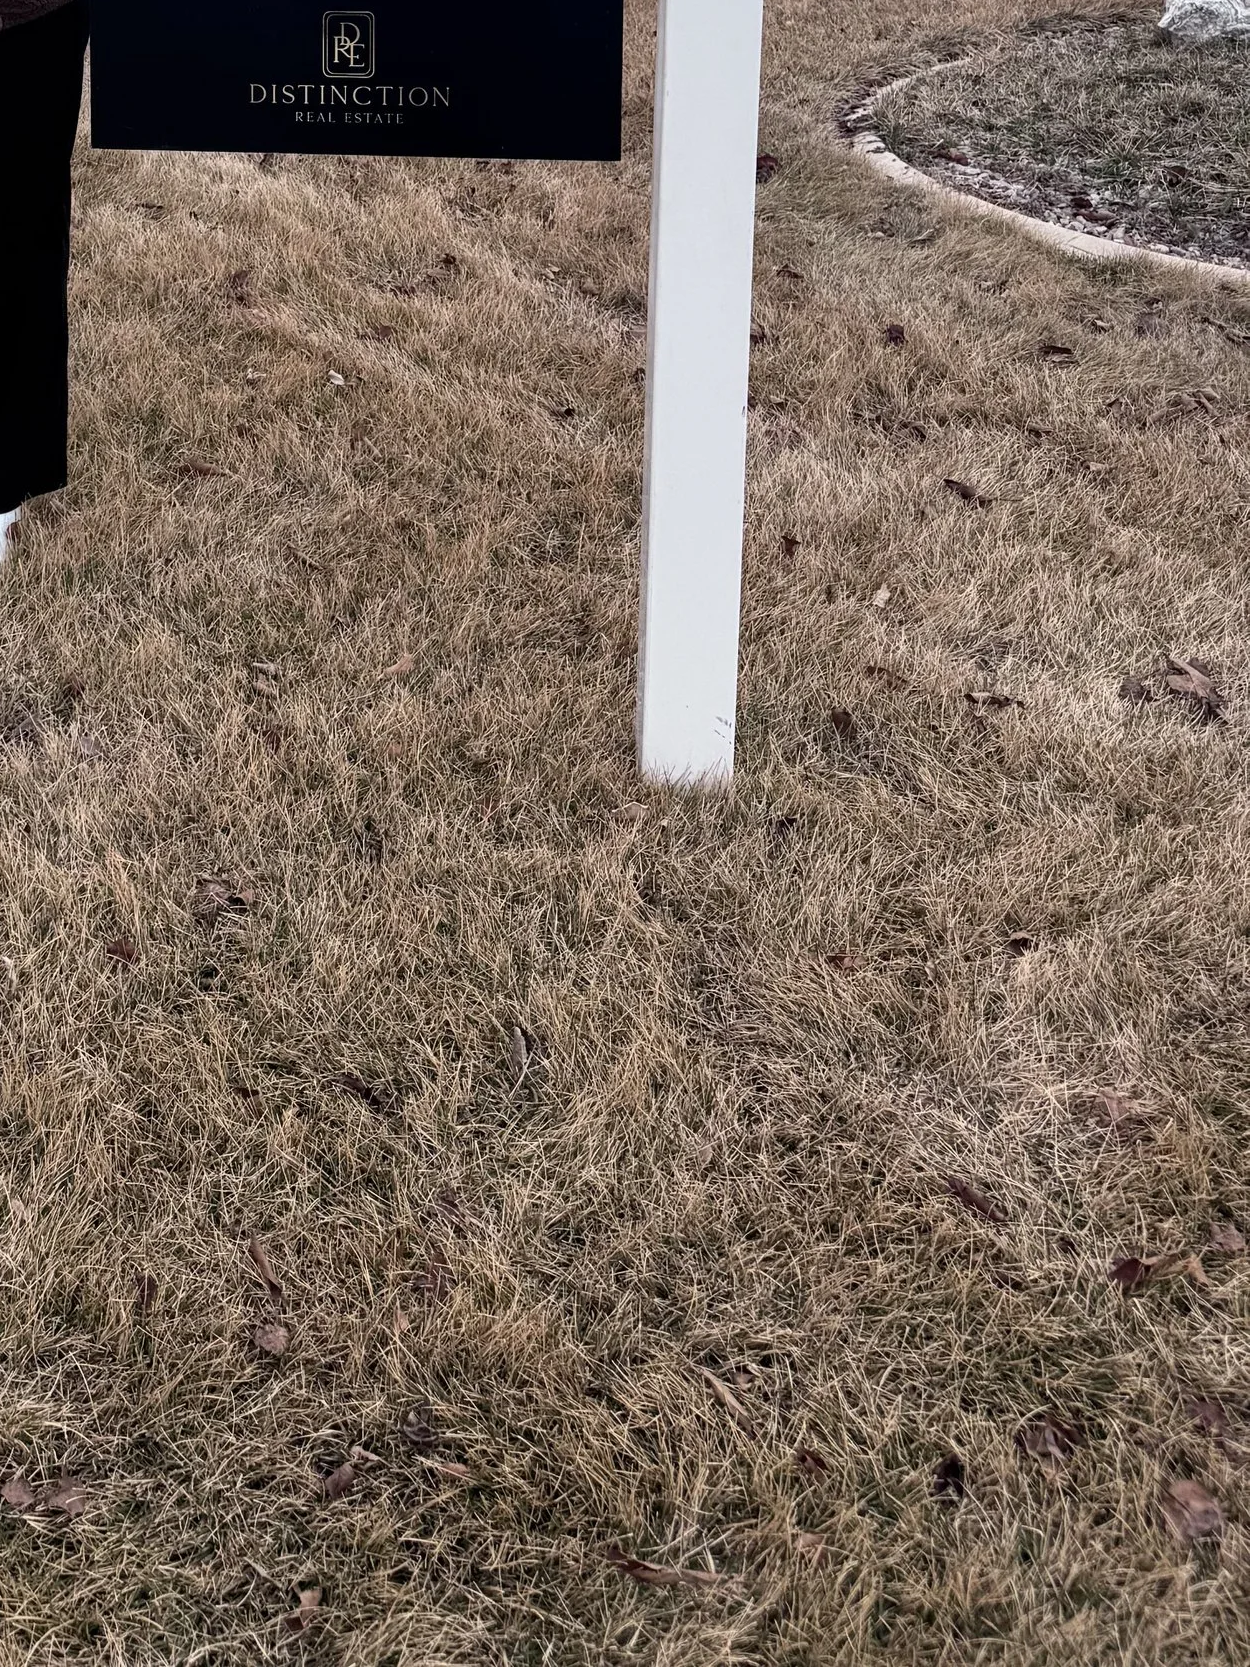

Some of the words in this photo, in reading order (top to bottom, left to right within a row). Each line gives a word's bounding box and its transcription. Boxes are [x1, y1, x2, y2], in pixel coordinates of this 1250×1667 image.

[249, 83, 450, 107] DISTINCTION
[295, 111, 336, 123] REAL
[344, 112, 404, 125] ESTATE
